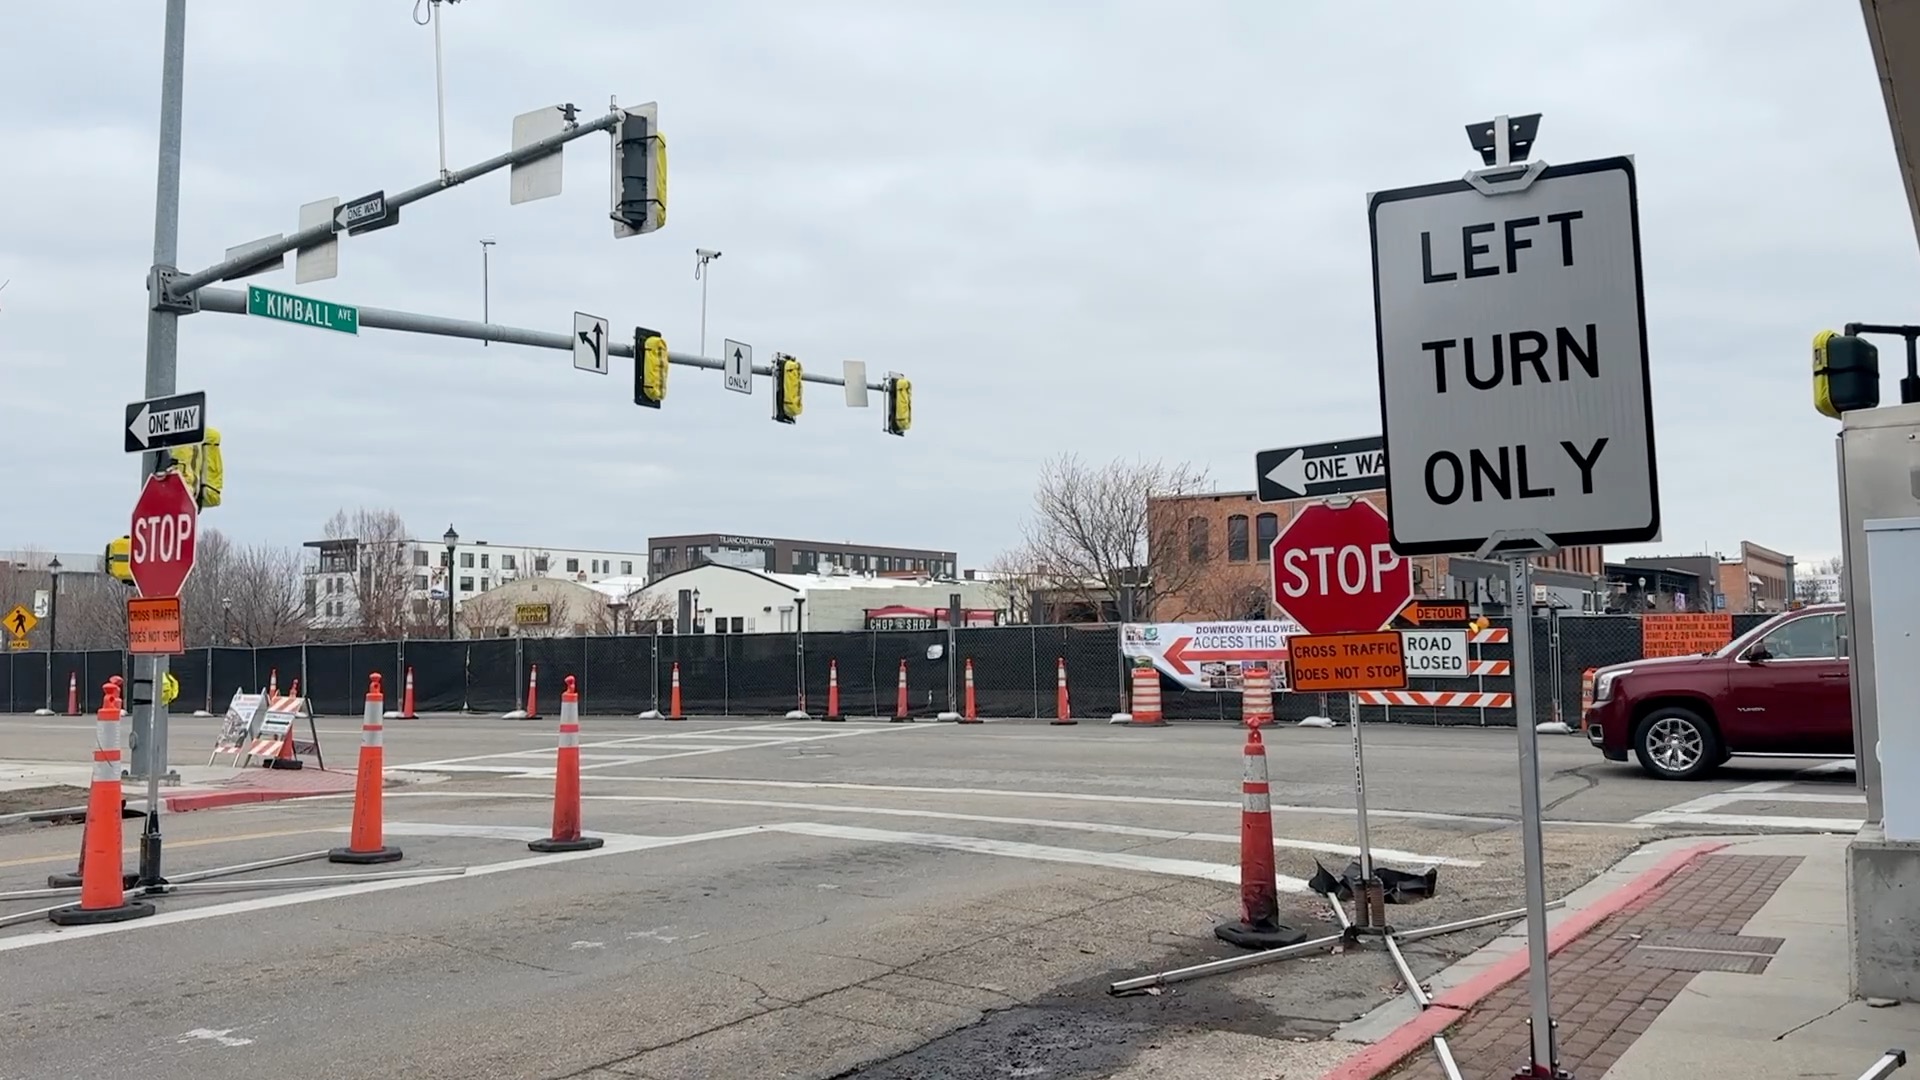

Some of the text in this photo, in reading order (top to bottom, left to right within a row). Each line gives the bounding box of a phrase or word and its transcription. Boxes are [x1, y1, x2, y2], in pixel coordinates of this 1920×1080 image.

[347, 200, 379, 220] ONE WAY
[1420, 210, 1583, 284] LEFT
[254, 291, 352, 327] S KIMBALL AVE
[1421, 323, 1599, 393] TURN
[728, 376, 748, 389] ONLY
[148, 407, 197, 434] ONE WAY
[1304, 453, 1385, 481] ONE WA
[1424, 437, 1609, 505] ONLY
[133, 513, 192, 564] STOP
[1282, 543, 1400, 598] STOP
[130, 608, 179, 621] CROSS TRAFFIC
[1416, 608, 1462, 620] DETOUR
[870, 619, 932, 630] CHOP SHOP
[1195, 624, 1301, 634] DOWNTOWN CALDWEL
[130, 631, 179, 643] DOES NOT STOP
[1193, 637, 1244, 649] ACCESS
[1246, 636, 1277, 648] THIS
[1408, 637, 1451, 651] ROAD
[1294, 642, 1398, 659] CROSS TRAFFIC
[1296, 665, 1401, 681] DOES NOT STOP
